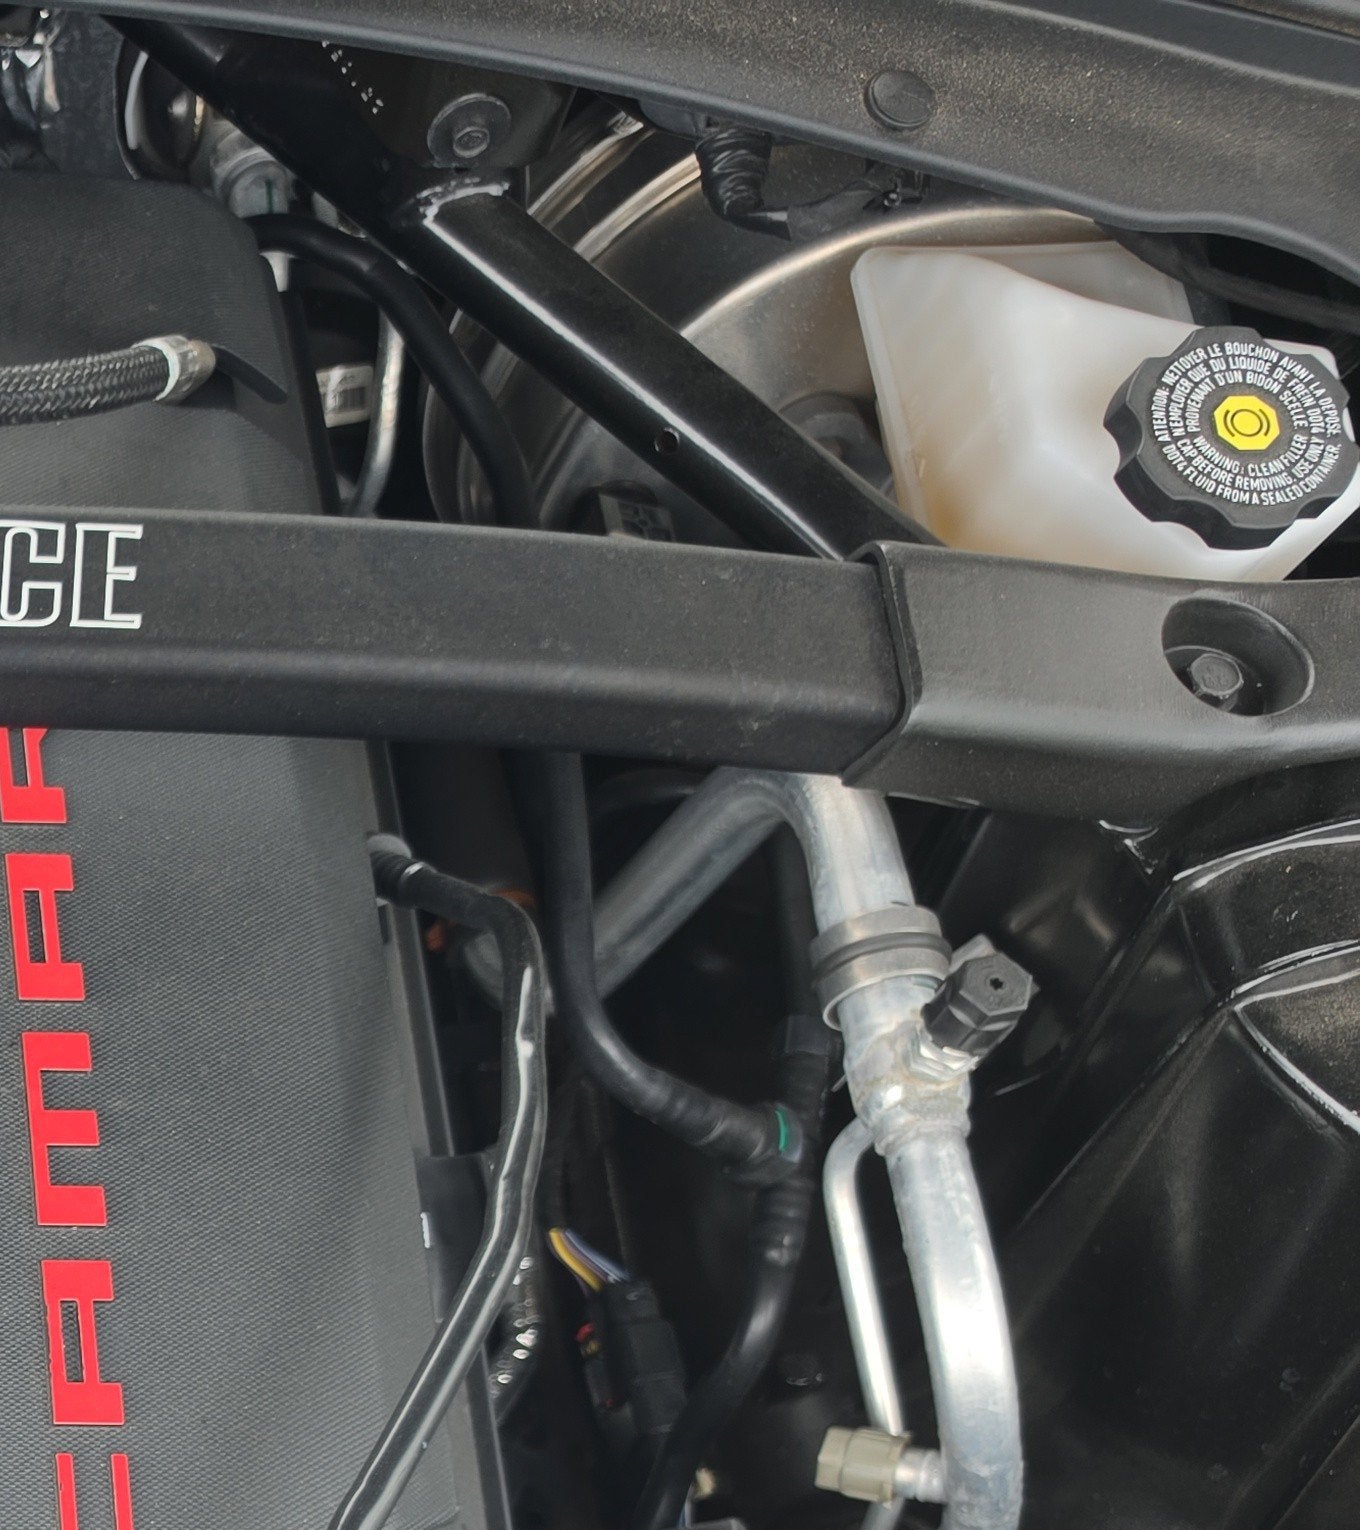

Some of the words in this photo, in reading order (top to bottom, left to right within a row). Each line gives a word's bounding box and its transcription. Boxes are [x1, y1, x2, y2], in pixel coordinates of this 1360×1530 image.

[1151, 386, 1171, 441] ATTENTION:
[1161, 347, 1208, 386] NETTOYER
[1207, 343, 1223, 357] LE
[1224, 341, 1279, 363] BOUCHON
[1279, 356, 1315, 383] AVANT
[1309, 381, 1326, 398] LA
[1185, 377, 1216, 432] PROVENANT
[1214, 370, 1243, 386] D'UN
[1245, 371, 1282, 394] BIDON
[1187, 363, 1211, 382] QUE
[1209, 357, 1226, 372] DU
[1228, 356, 1272, 375] LIQUIDE
[1272, 367, 1290, 383] DE
[1287, 378, 1316, 407] FREIN
[1177, 438, 1198, 458] CAP
[1192, 455, 1234, 486] BEFORE
[1292, 458, 1314, 478] USE
[1305, 436, 1325, 462] ONLY
[1247, 458, 1285, 477] CLEAN
[1280, 434, 1308, 466] FILLER
[1183, 466, 1216, 493] FLUID
[1216, 484, 1250, 504] FROM
[1252, 492, 1260, 505] A
[1260, 485, 1303, 505] SEALED
